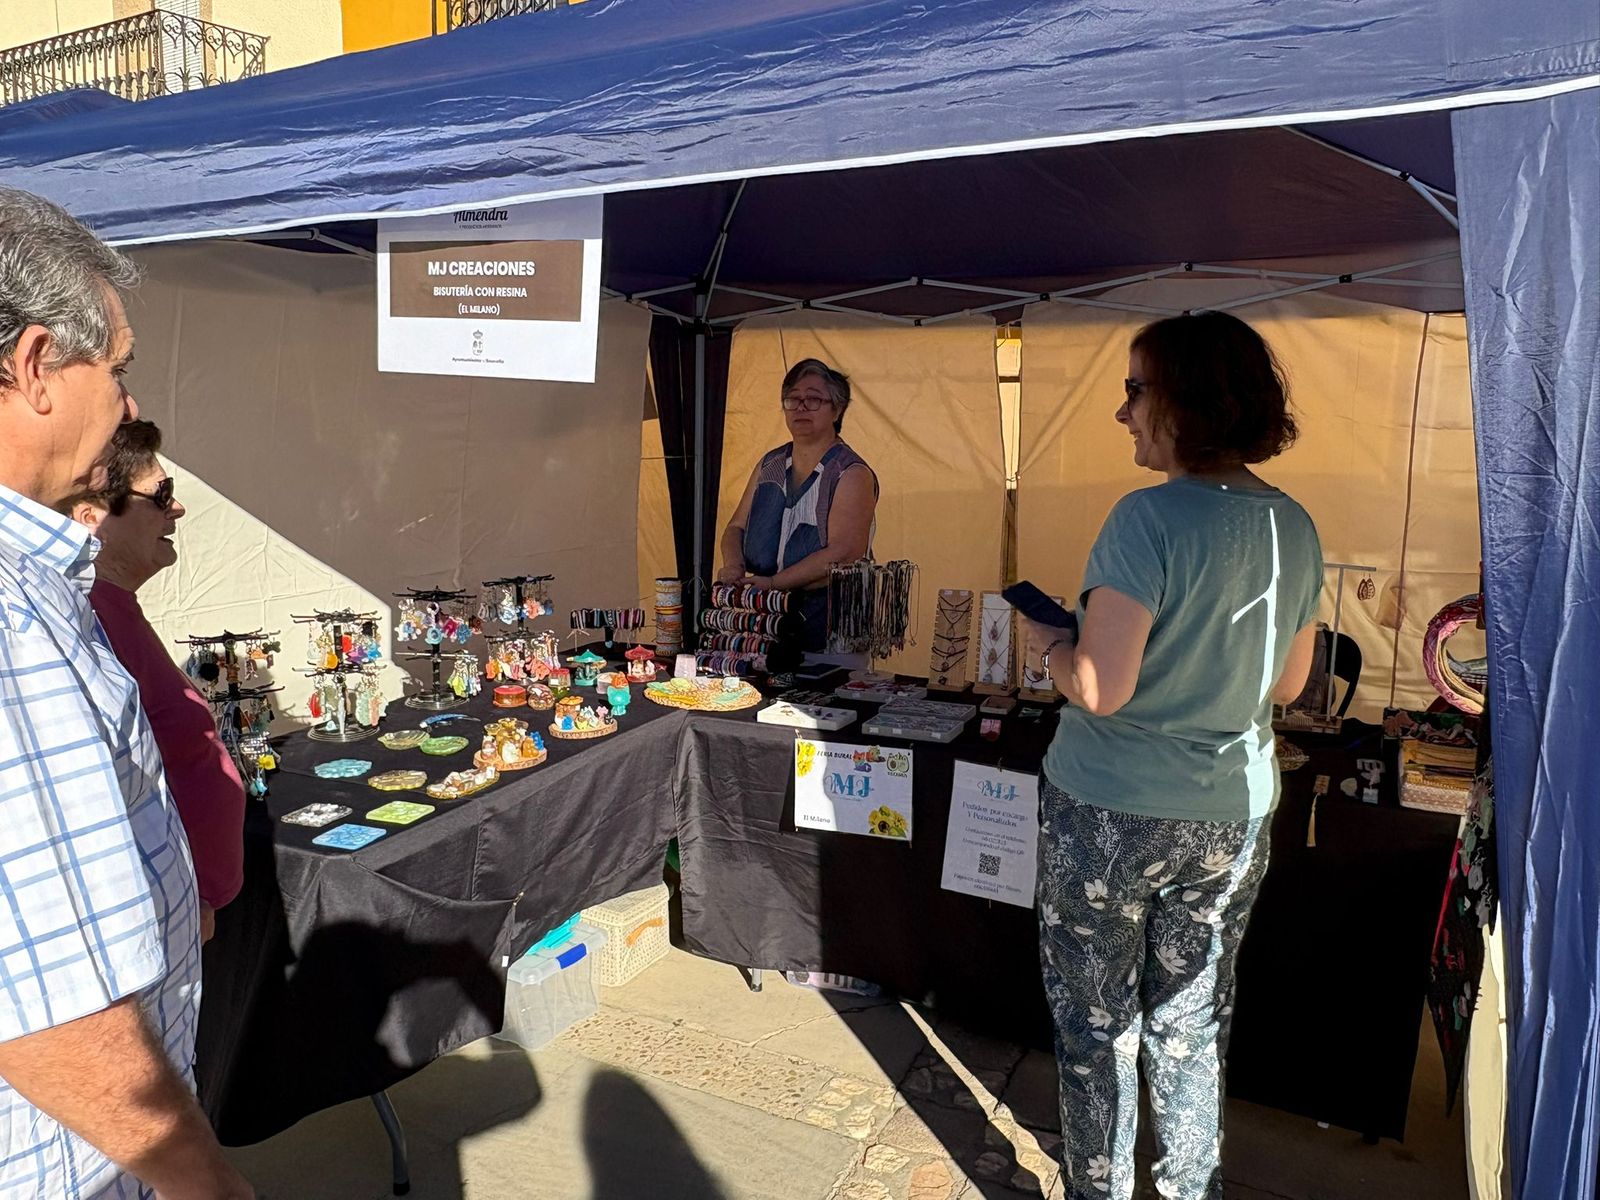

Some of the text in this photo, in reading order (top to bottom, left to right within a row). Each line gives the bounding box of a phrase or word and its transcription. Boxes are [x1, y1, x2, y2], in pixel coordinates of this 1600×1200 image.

[428, 261, 536, 277] MJ CREACIONES
[433, 284, 528, 299] BISUTERÍA CON RESINA
[458, 303, 501, 316] (EL MILANO)
[824, 772, 875, 798] MJ
[976, 779, 1020, 802] MJ
